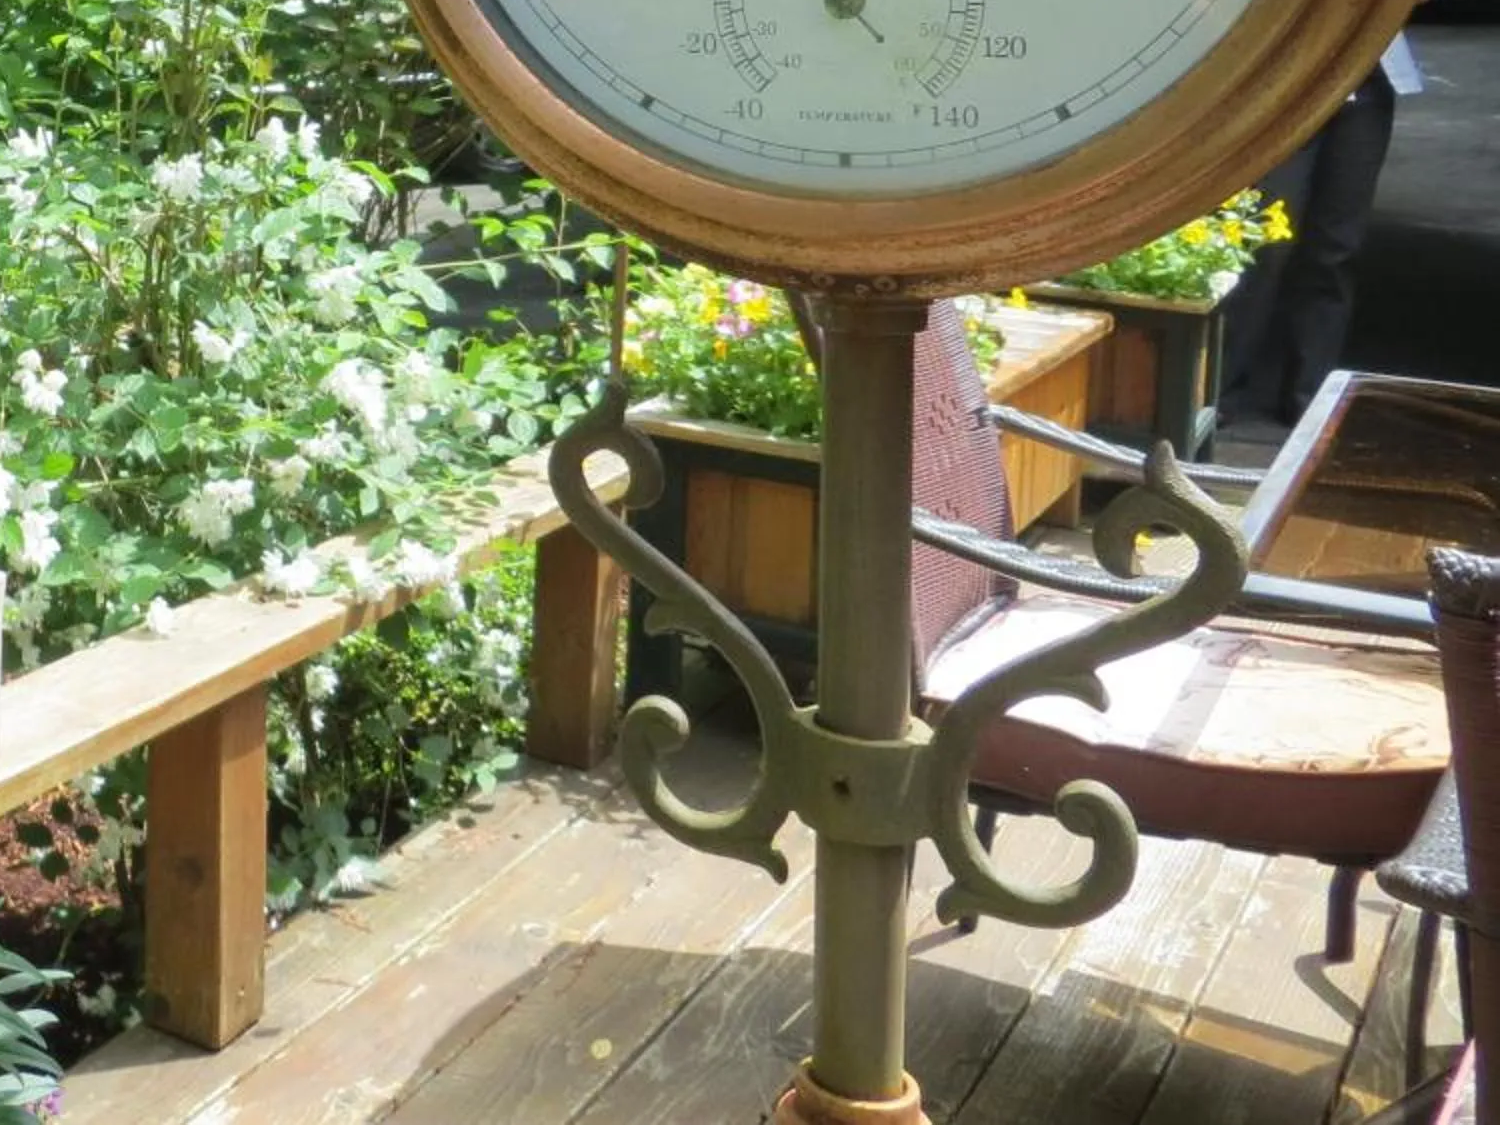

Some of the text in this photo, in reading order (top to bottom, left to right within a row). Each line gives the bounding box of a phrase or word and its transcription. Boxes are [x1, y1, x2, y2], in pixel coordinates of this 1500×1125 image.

[678, 32, 718, 56] -20
[982, 36, 1027, 59] 120
[930, 104, 980, 129] 140
